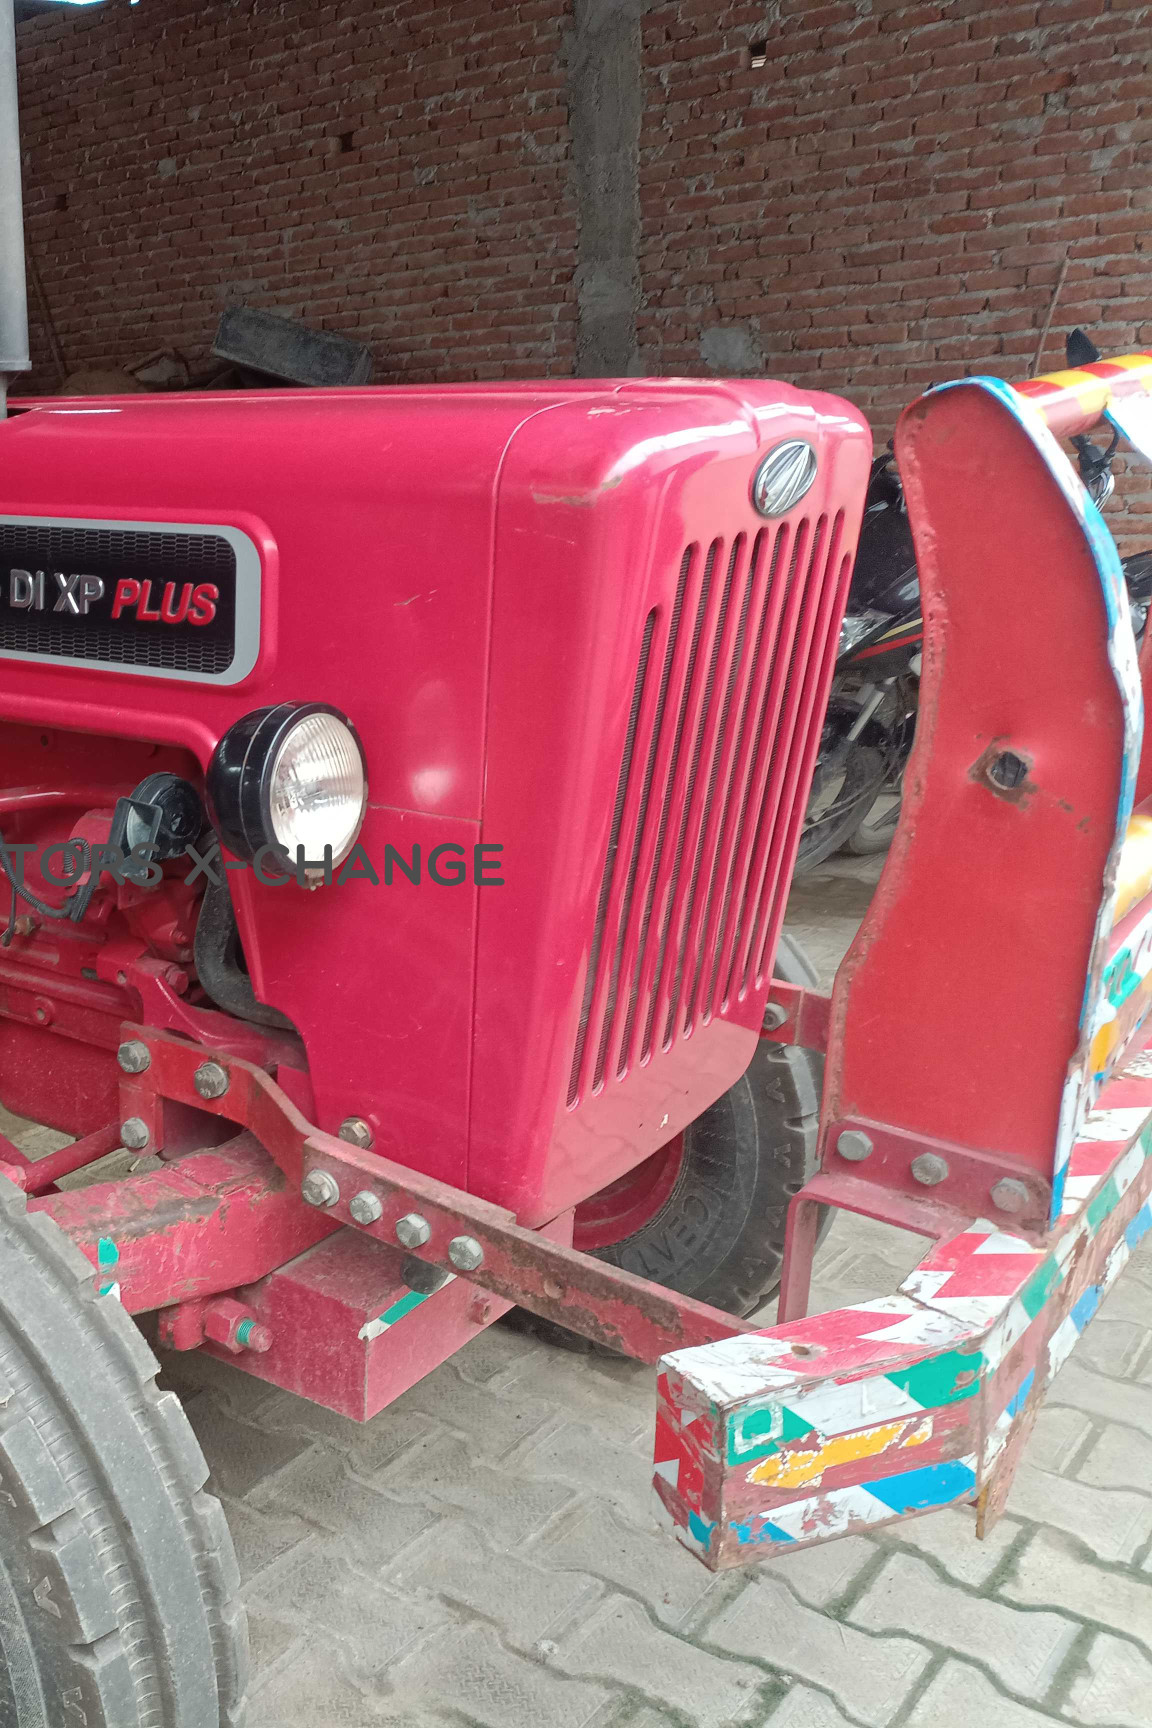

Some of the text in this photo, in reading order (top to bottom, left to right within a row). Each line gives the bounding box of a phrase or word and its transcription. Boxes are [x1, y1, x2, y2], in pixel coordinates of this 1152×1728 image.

[10, 569, 45, 611] DI
[53, 572, 105, 615] XP
[111, 578, 219, 626] PLUS
